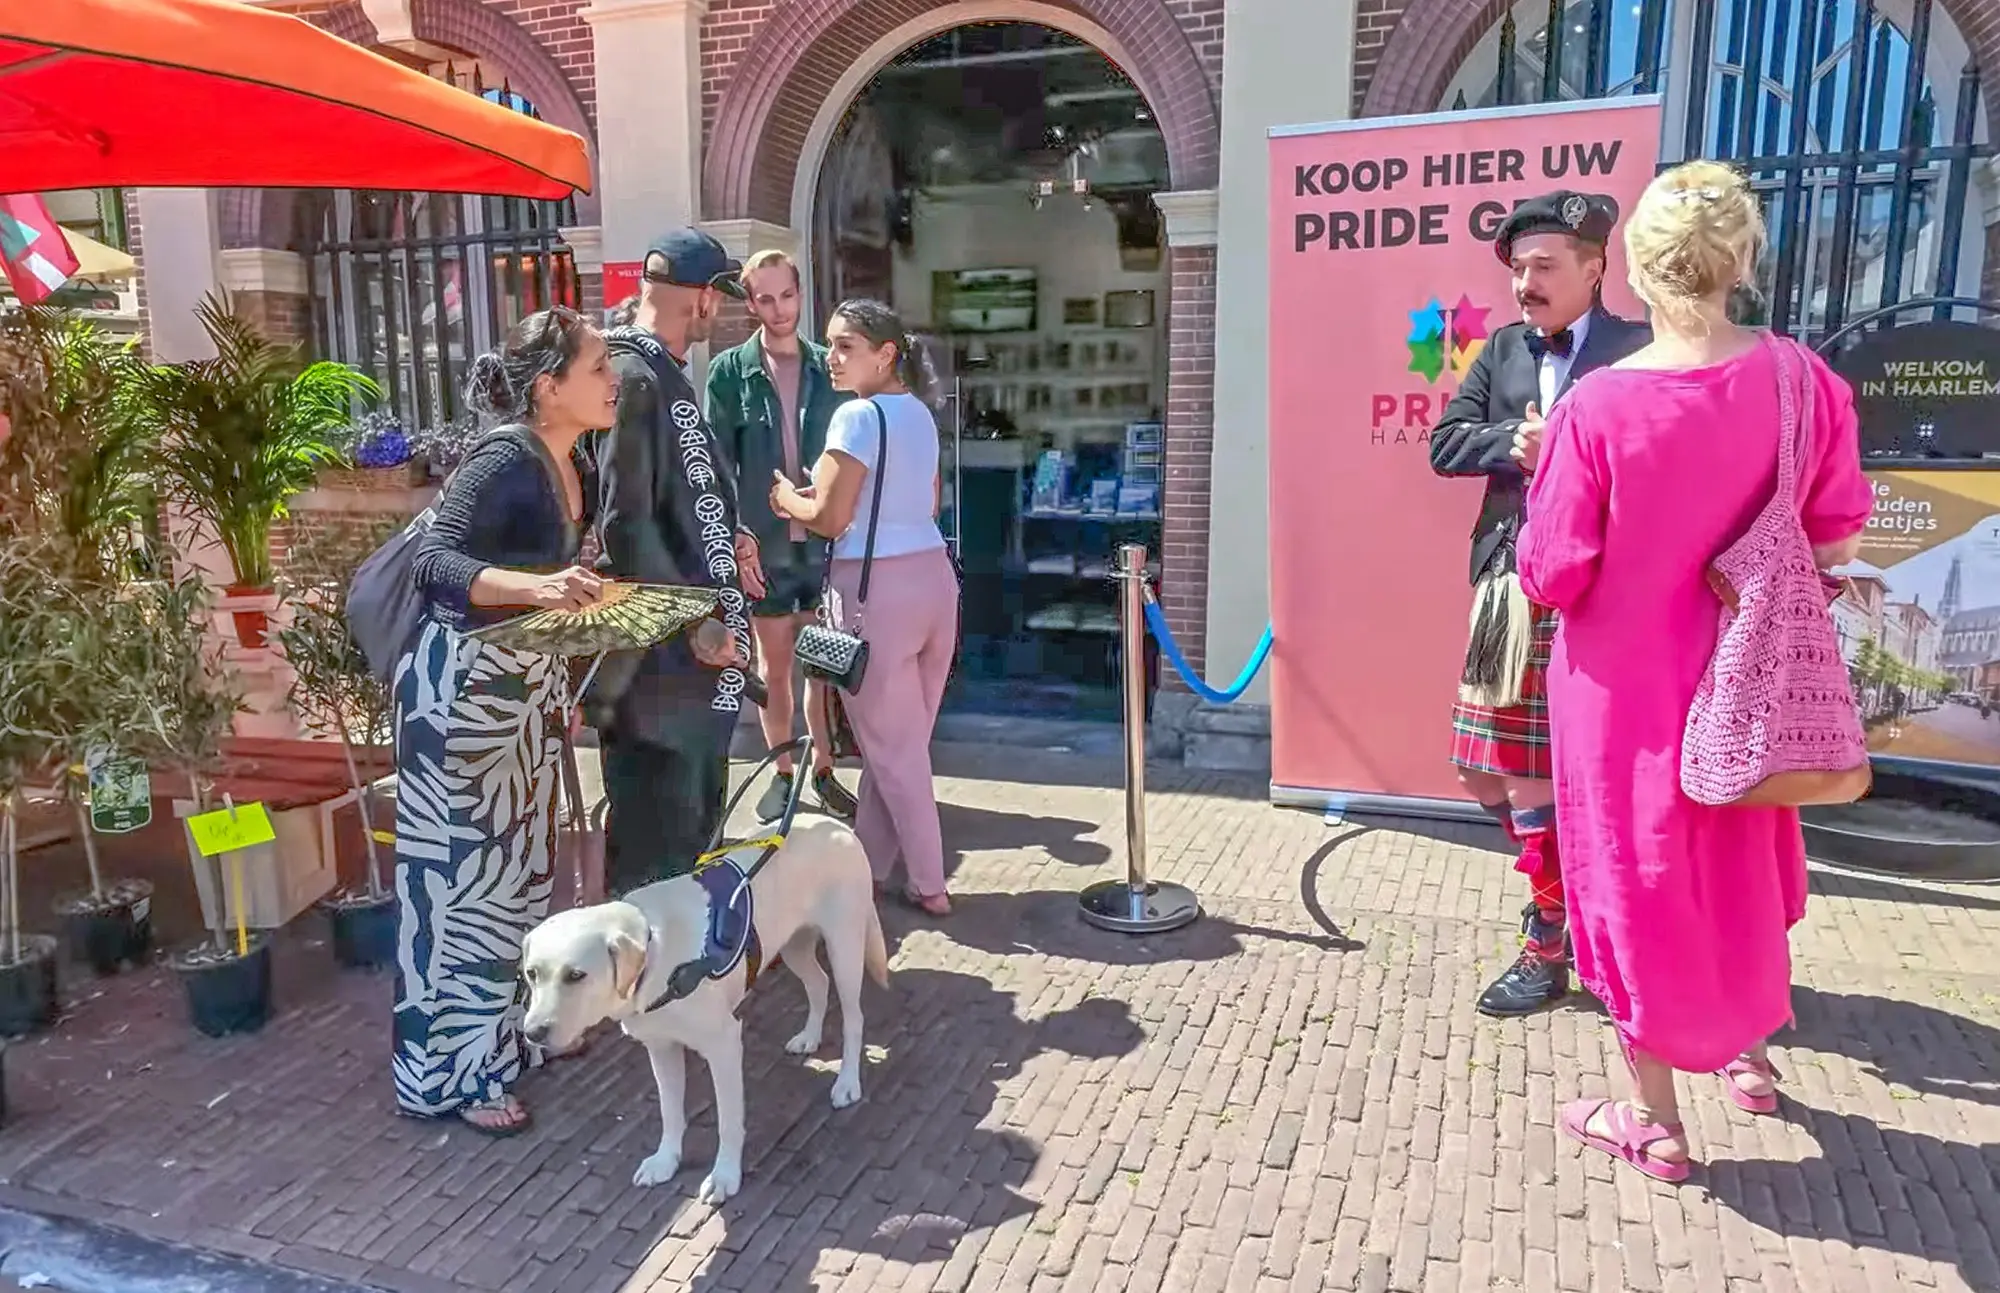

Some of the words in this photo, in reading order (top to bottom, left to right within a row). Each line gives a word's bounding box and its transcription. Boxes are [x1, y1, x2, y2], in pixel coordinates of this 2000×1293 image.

[1295, 158, 1408, 197] KOOP
[1423, 148, 1525, 188] HIER
[1541, 140, 1623, 179] UW
[1295, 204, 1449, 252] PRIDE
[1883, 360, 1985, 377] WELKOM
[1862, 380, 1886, 396] IN
[1893, 380, 2000, 396] HAARLEM
[1872, 496, 1932, 513] uden
